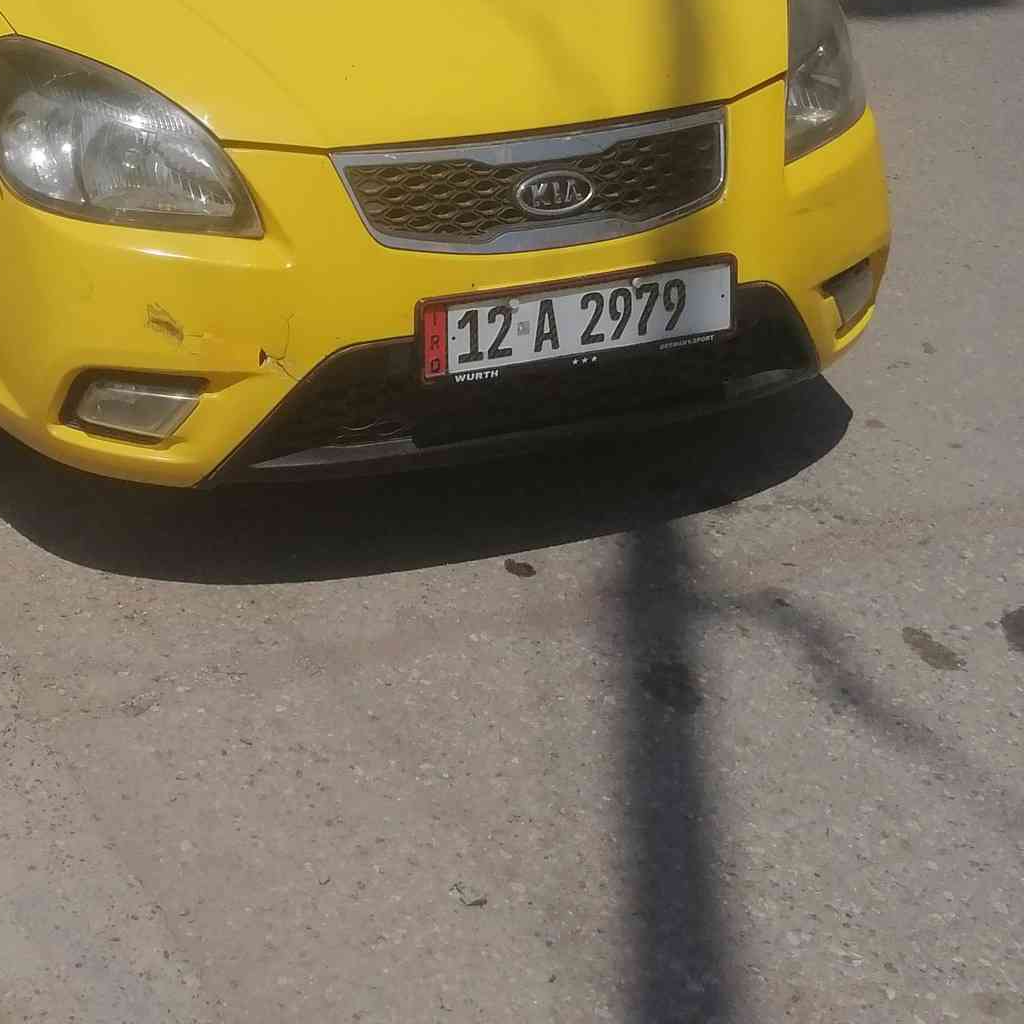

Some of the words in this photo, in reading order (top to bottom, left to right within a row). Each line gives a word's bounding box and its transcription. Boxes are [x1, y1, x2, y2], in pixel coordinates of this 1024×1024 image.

[531, 179, 582, 206] KIA
[458, 306, 513, 364] 12
[534, 299, 559, 352] A
[580, 279, 686, 345] 2979
